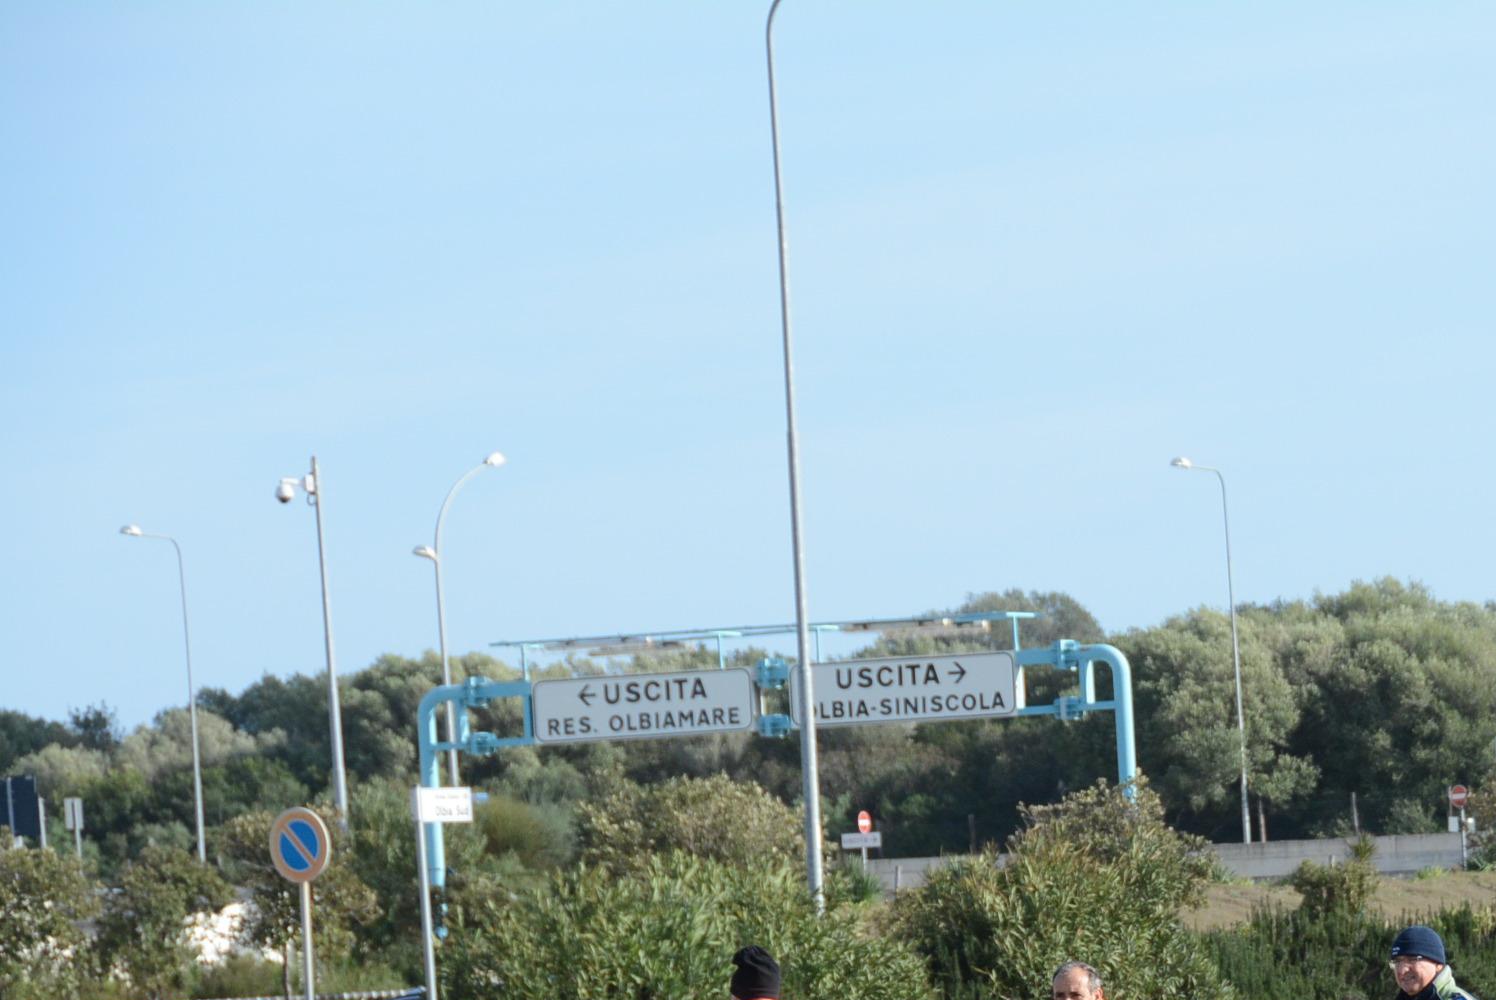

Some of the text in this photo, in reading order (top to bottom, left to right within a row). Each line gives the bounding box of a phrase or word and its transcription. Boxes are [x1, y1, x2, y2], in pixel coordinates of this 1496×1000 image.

[836, 663, 940, 689] USCITA
[603, 677, 707, 704] USCITA
[812, 691, 1006, 719] LBIA-SINISCOLA
[547, 707, 740, 736] RES. OLBIAMARE
